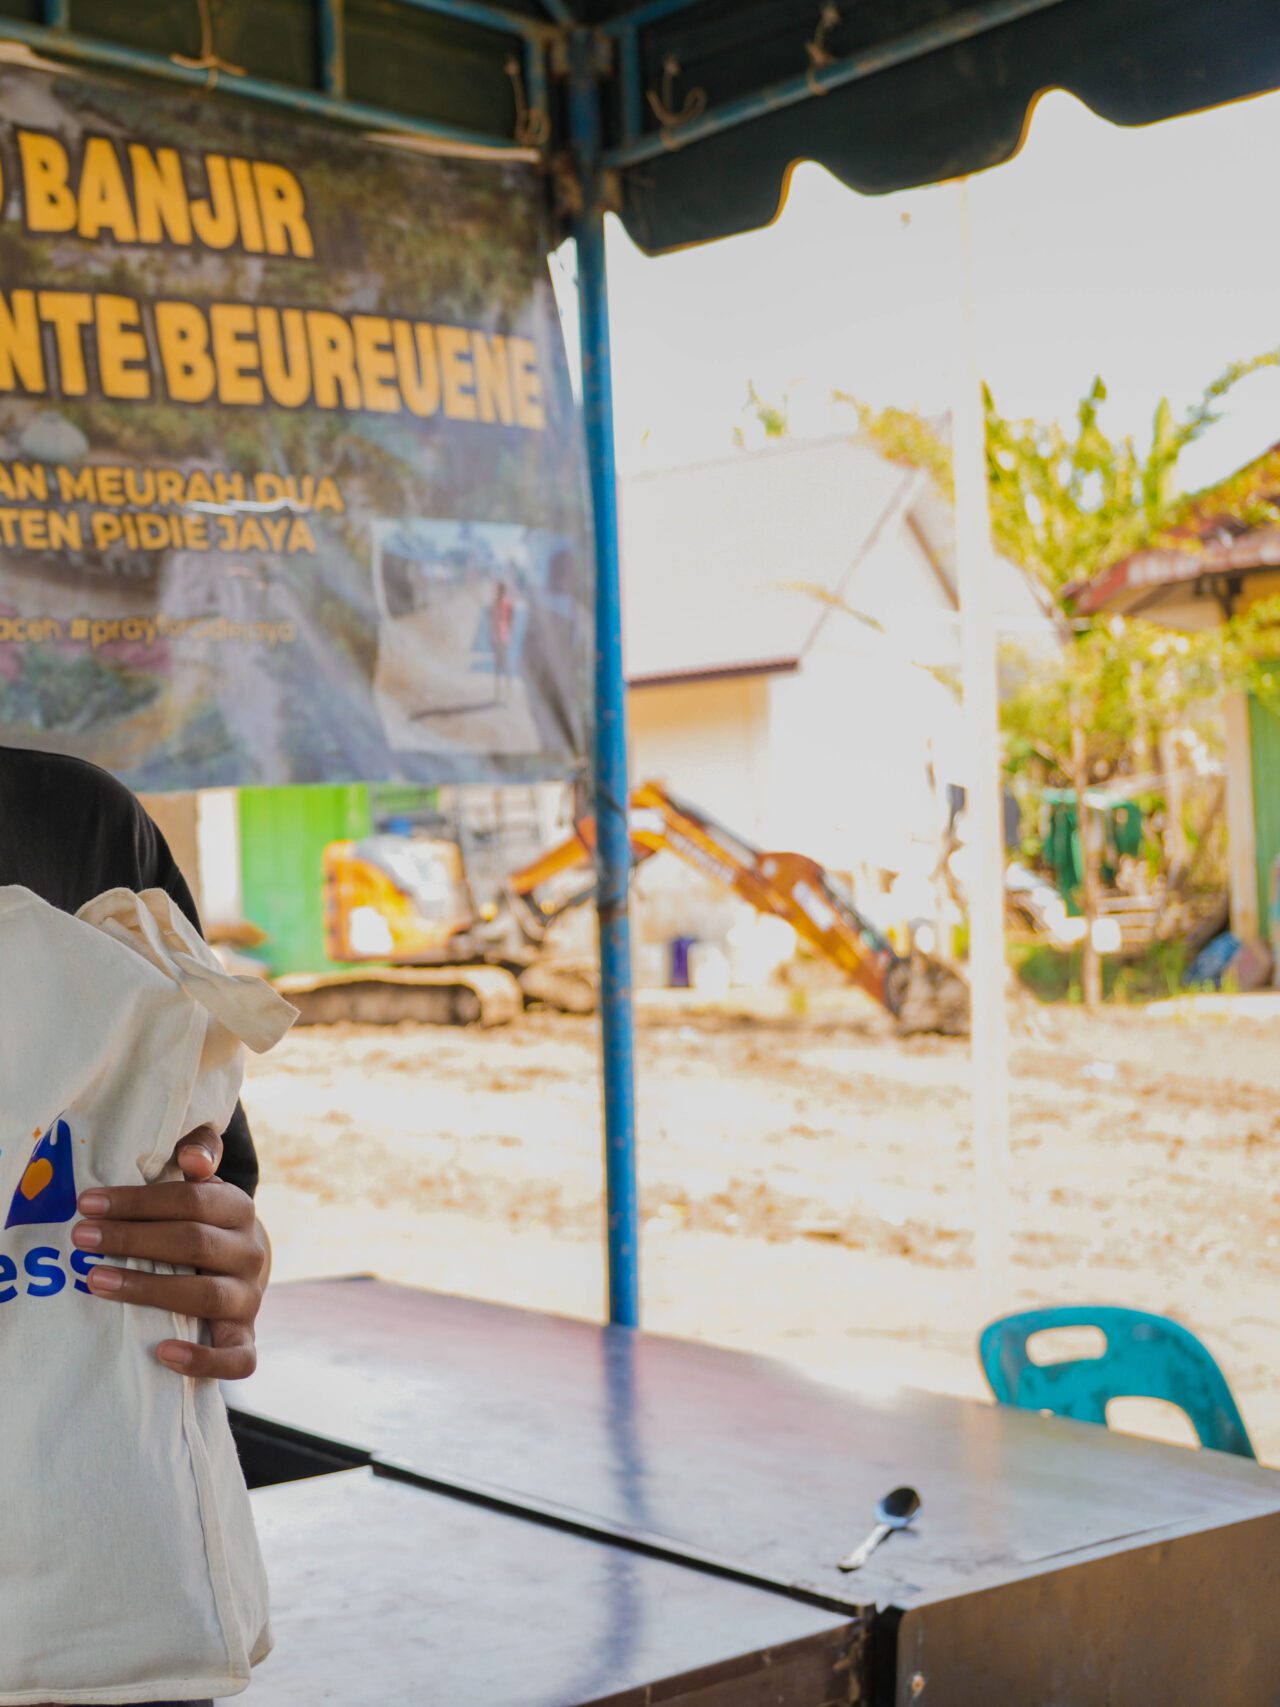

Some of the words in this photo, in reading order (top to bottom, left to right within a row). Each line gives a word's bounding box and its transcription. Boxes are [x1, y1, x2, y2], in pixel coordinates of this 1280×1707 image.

[18, 130, 315, 259] BANJIR
[154, 300, 545, 432] BEUREUENE
[56, 464, 246, 508] MEURAH
[254, 471, 344, 514] DUA
[91, 511, 210, 551] PIDIE
[217, 515, 317, 555] JAYA
